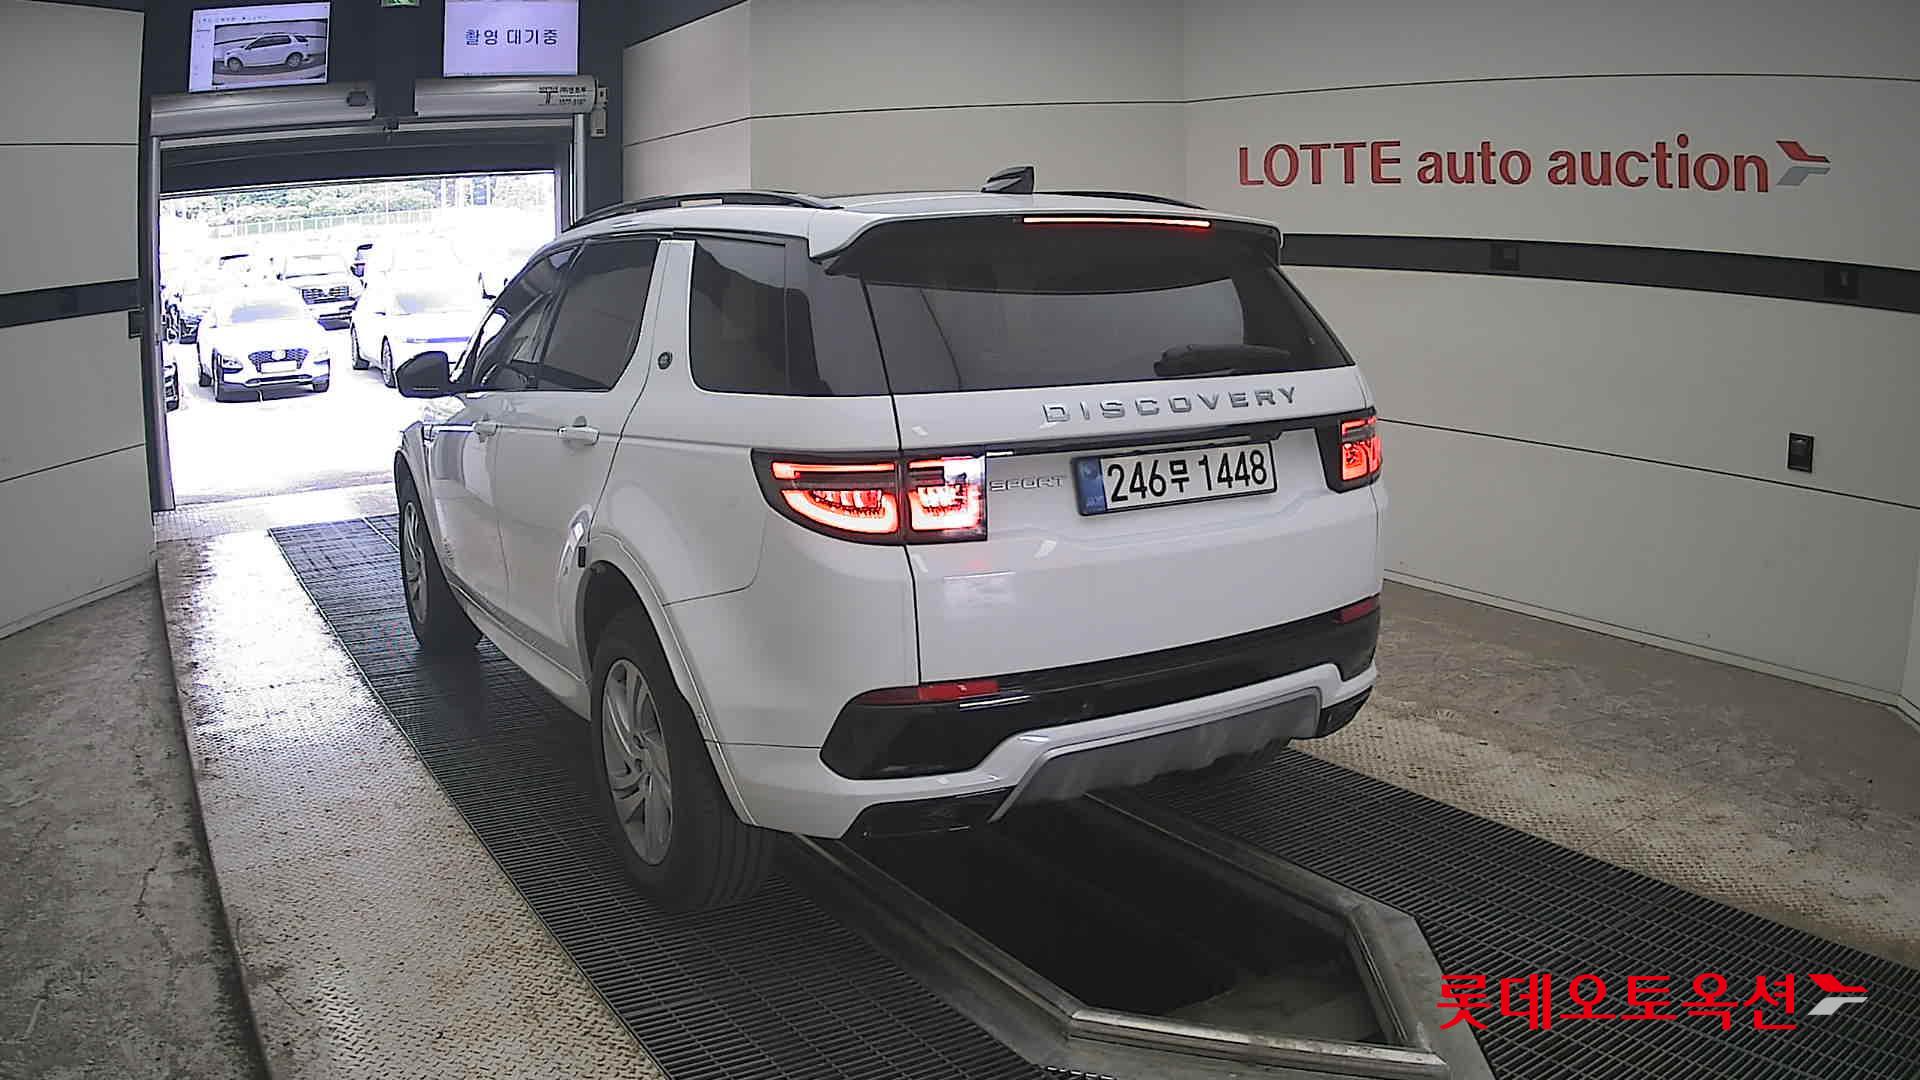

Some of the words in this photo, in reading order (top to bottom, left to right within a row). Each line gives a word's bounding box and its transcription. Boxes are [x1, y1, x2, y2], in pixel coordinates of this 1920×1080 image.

[465, 28, 499, 46] 촬영
[506, 28, 558, 45] 대기중
[1239, 140, 1400, 187] LOTTE
[1416, 140, 1532, 186] auto
[1547, 133, 1769, 192] auction
[1043, 386, 1296, 423] DISCOVERY
[989, 476, 1065, 492] SPORT
[1107, 459, 1190, 503] 246무
[1198, 450, 1267, 491] 1448
